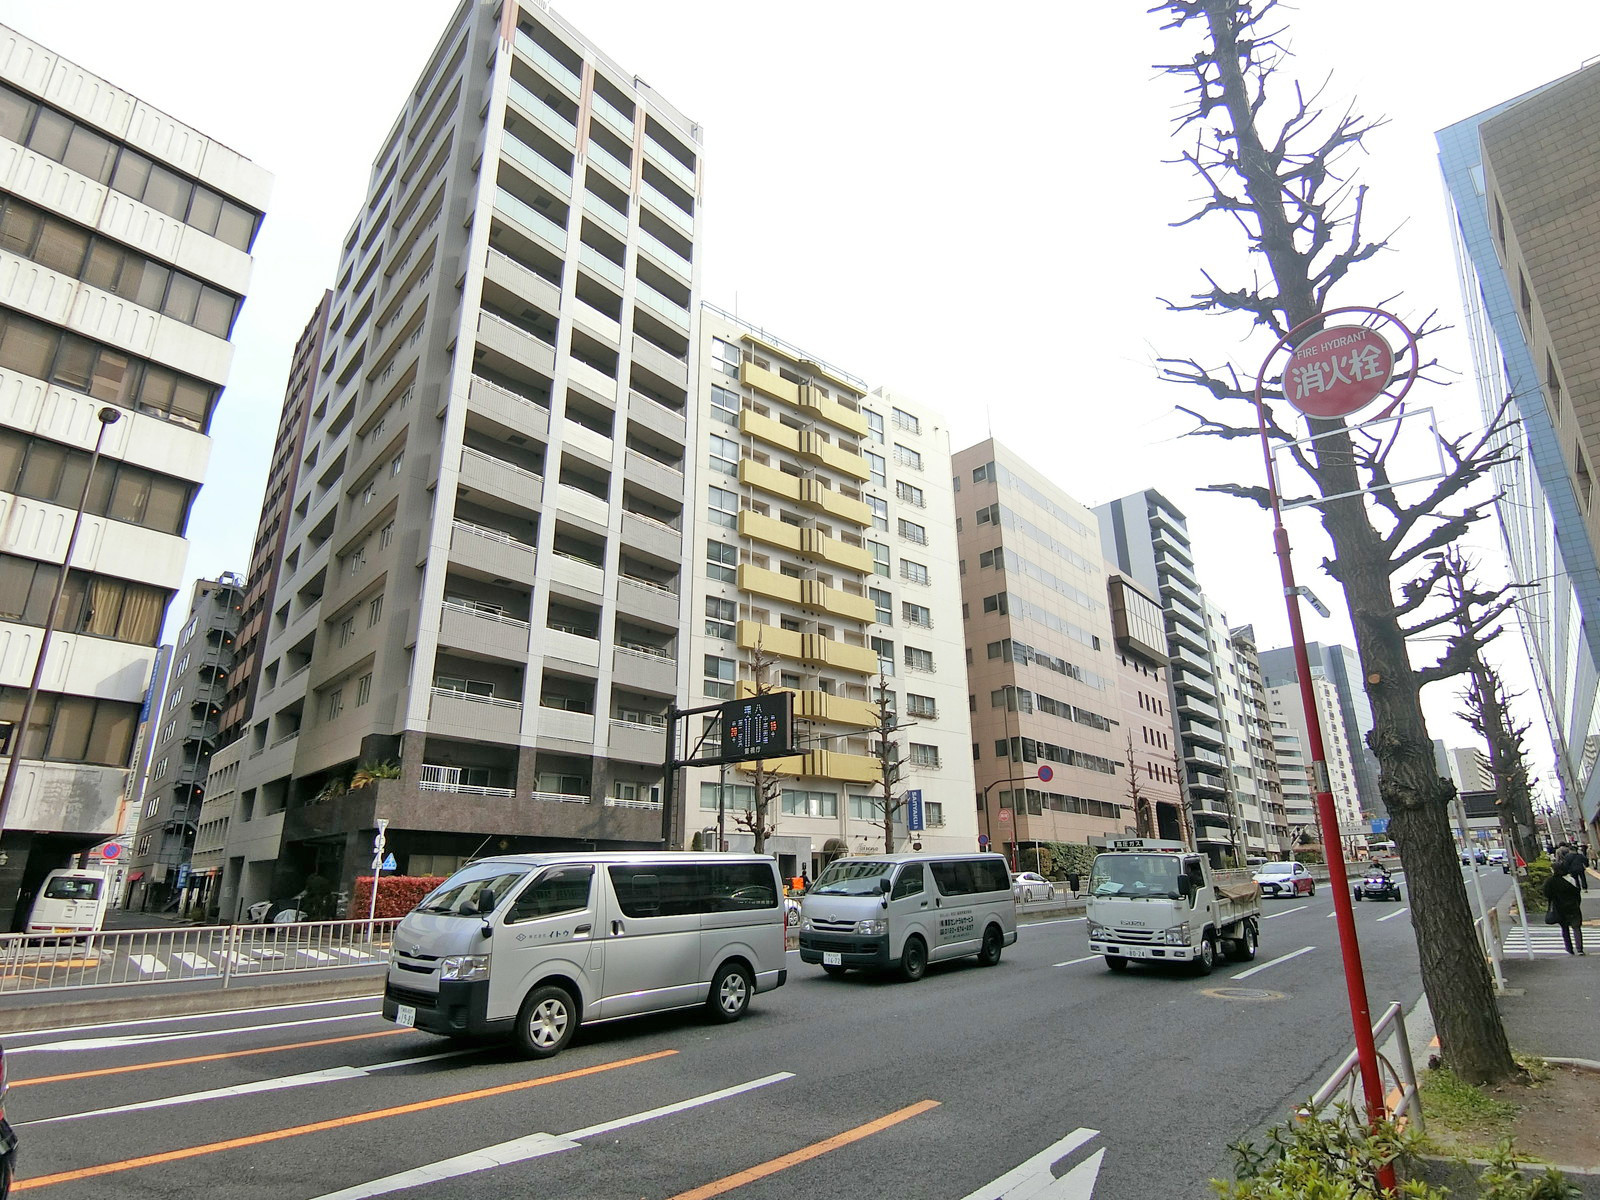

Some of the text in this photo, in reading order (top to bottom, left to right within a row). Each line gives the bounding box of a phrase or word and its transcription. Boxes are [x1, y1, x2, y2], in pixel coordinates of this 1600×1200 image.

[1297, 330, 1368, 361] FIRE HYDRANT
[1291, 344, 1384, 400] 消火栓
